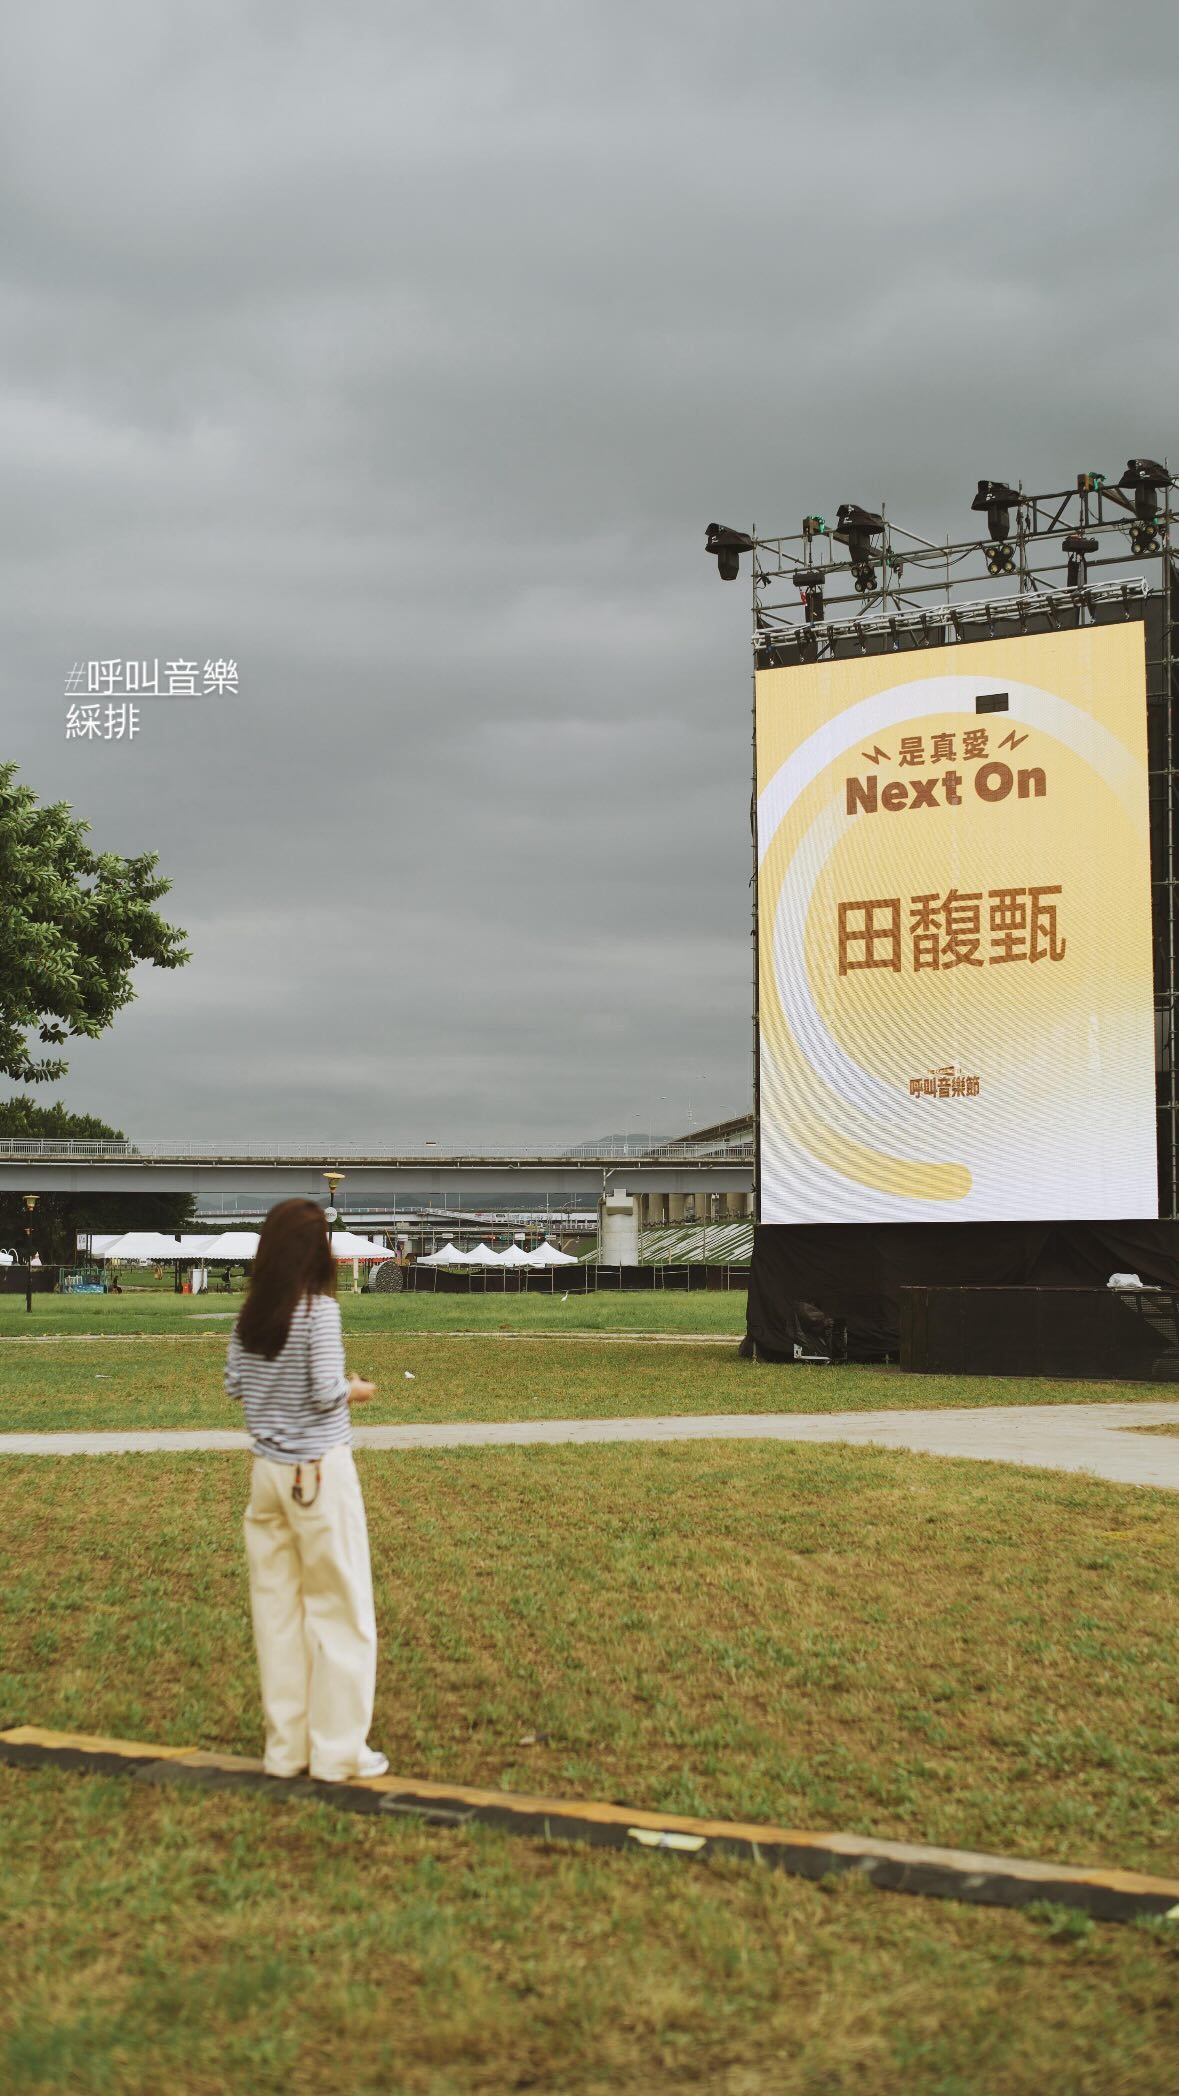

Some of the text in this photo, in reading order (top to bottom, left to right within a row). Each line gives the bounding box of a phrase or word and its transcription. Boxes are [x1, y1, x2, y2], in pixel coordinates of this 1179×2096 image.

[898, 728, 989, 767] 是真愛
[846, 761, 1047, 815] Next On
[838, 885, 1067, 977] 田馥甄
[909, 1076, 981, 1099] 呼叫音樂節
